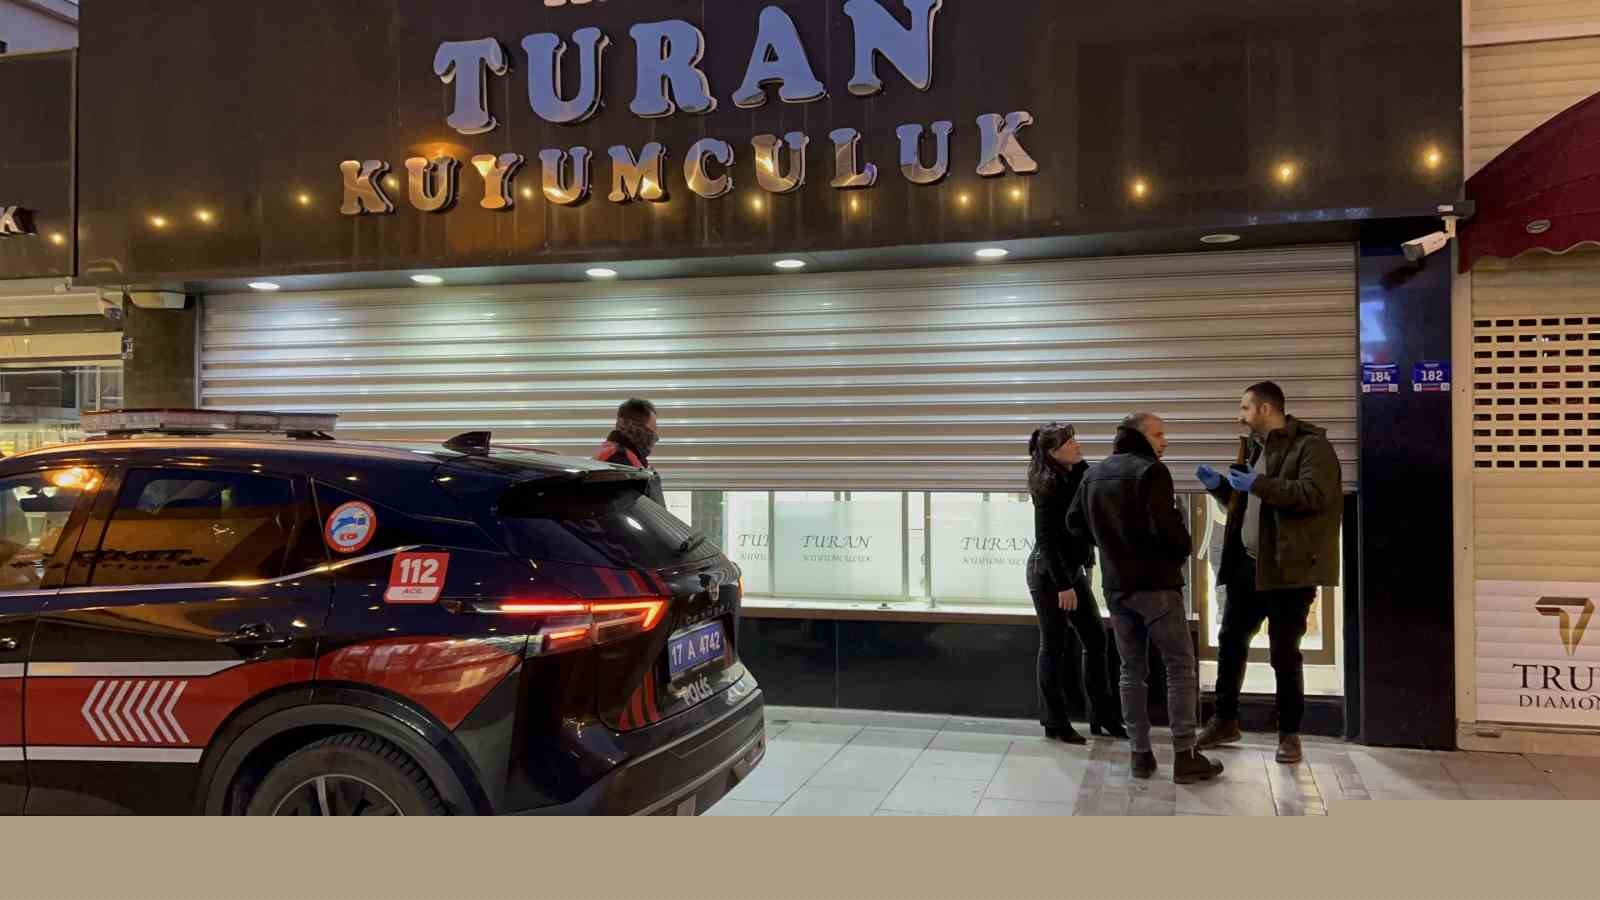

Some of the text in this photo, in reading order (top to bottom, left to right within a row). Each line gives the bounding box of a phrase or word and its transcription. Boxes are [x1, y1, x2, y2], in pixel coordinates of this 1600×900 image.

[433, 0, 942, 134] TURAN
[339, 110, 1038, 216] KUYUMCULUK
[1371, 371, 1391, 382] 184
[1421, 370, 1443, 381] 182
[800, 535, 872, 548] TURAN
[400, 558, 439, 584] 112
[672, 631, 720, 666] 17 A 4742
